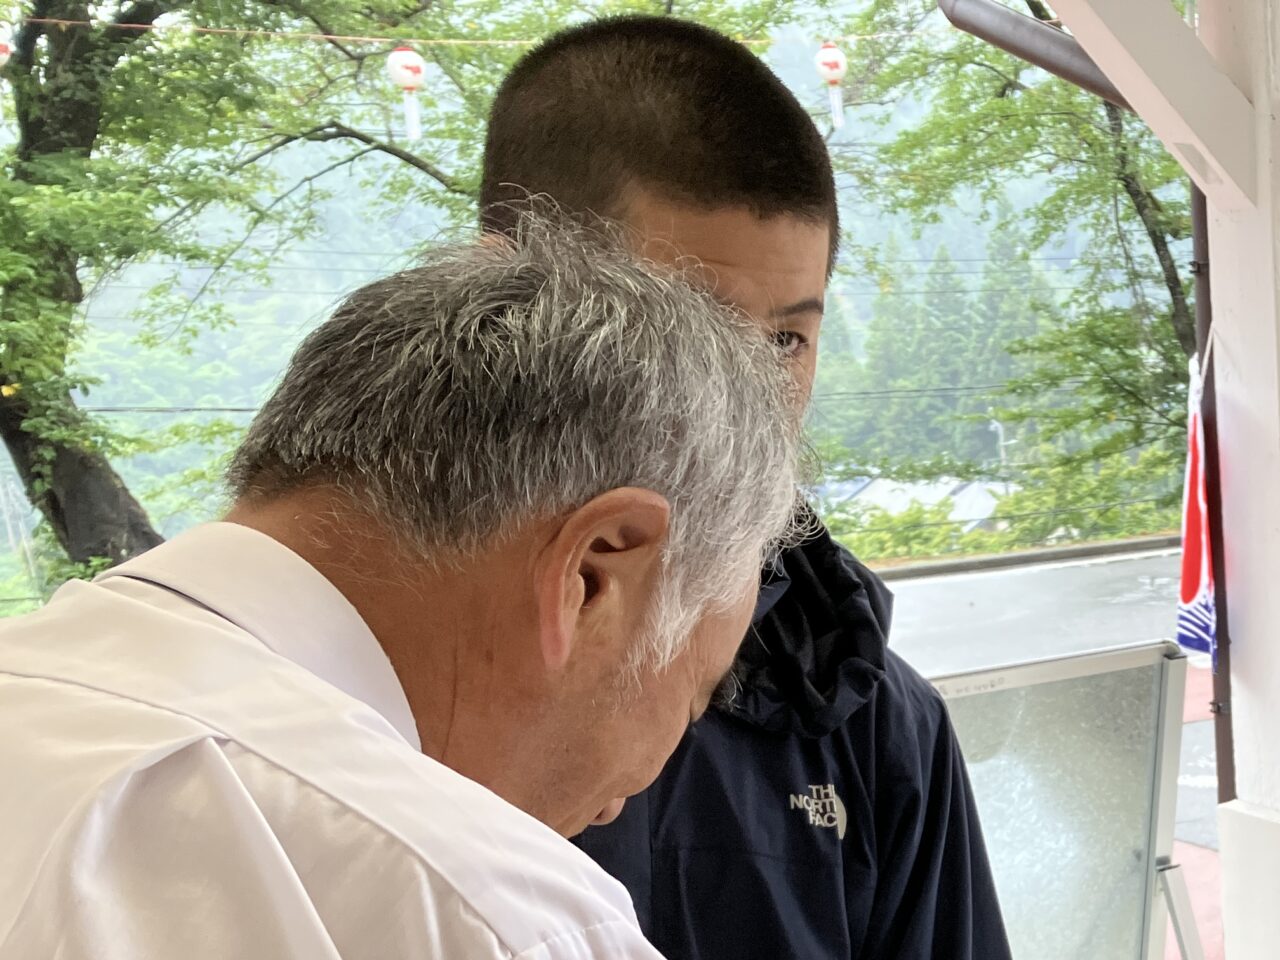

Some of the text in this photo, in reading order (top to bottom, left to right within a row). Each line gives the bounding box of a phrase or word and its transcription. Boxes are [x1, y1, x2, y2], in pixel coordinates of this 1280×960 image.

[808, 783, 836, 799] TH
[790, 794, 837, 813] NORT
[809, 810, 838, 828] FAC
